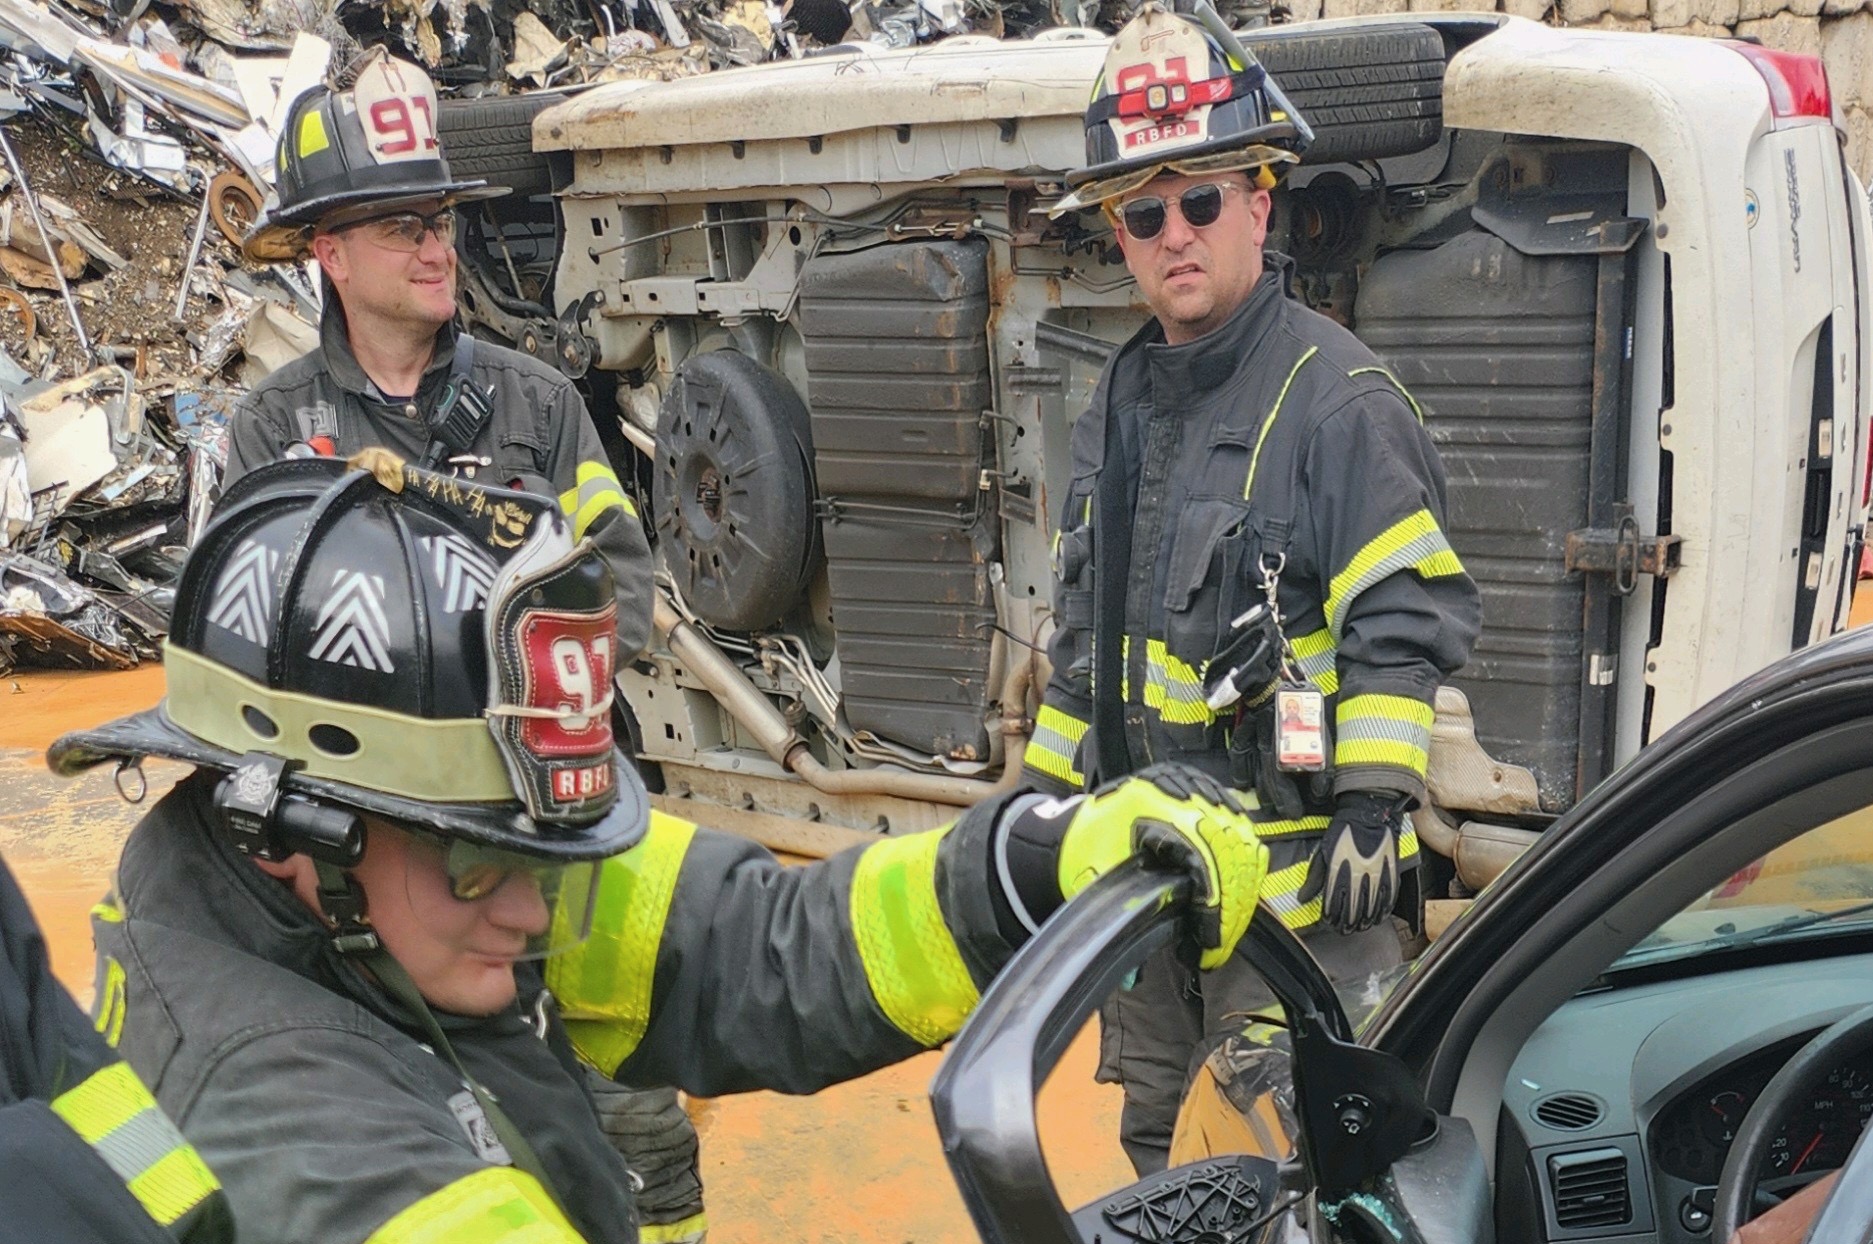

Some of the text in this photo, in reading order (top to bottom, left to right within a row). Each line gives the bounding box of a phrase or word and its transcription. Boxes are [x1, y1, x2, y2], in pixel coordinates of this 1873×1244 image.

[369, 96, 436, 155] 91
[1136, 123, 1187, 144] RBFD
[1814, 1100, 1833, 1109] MPH
